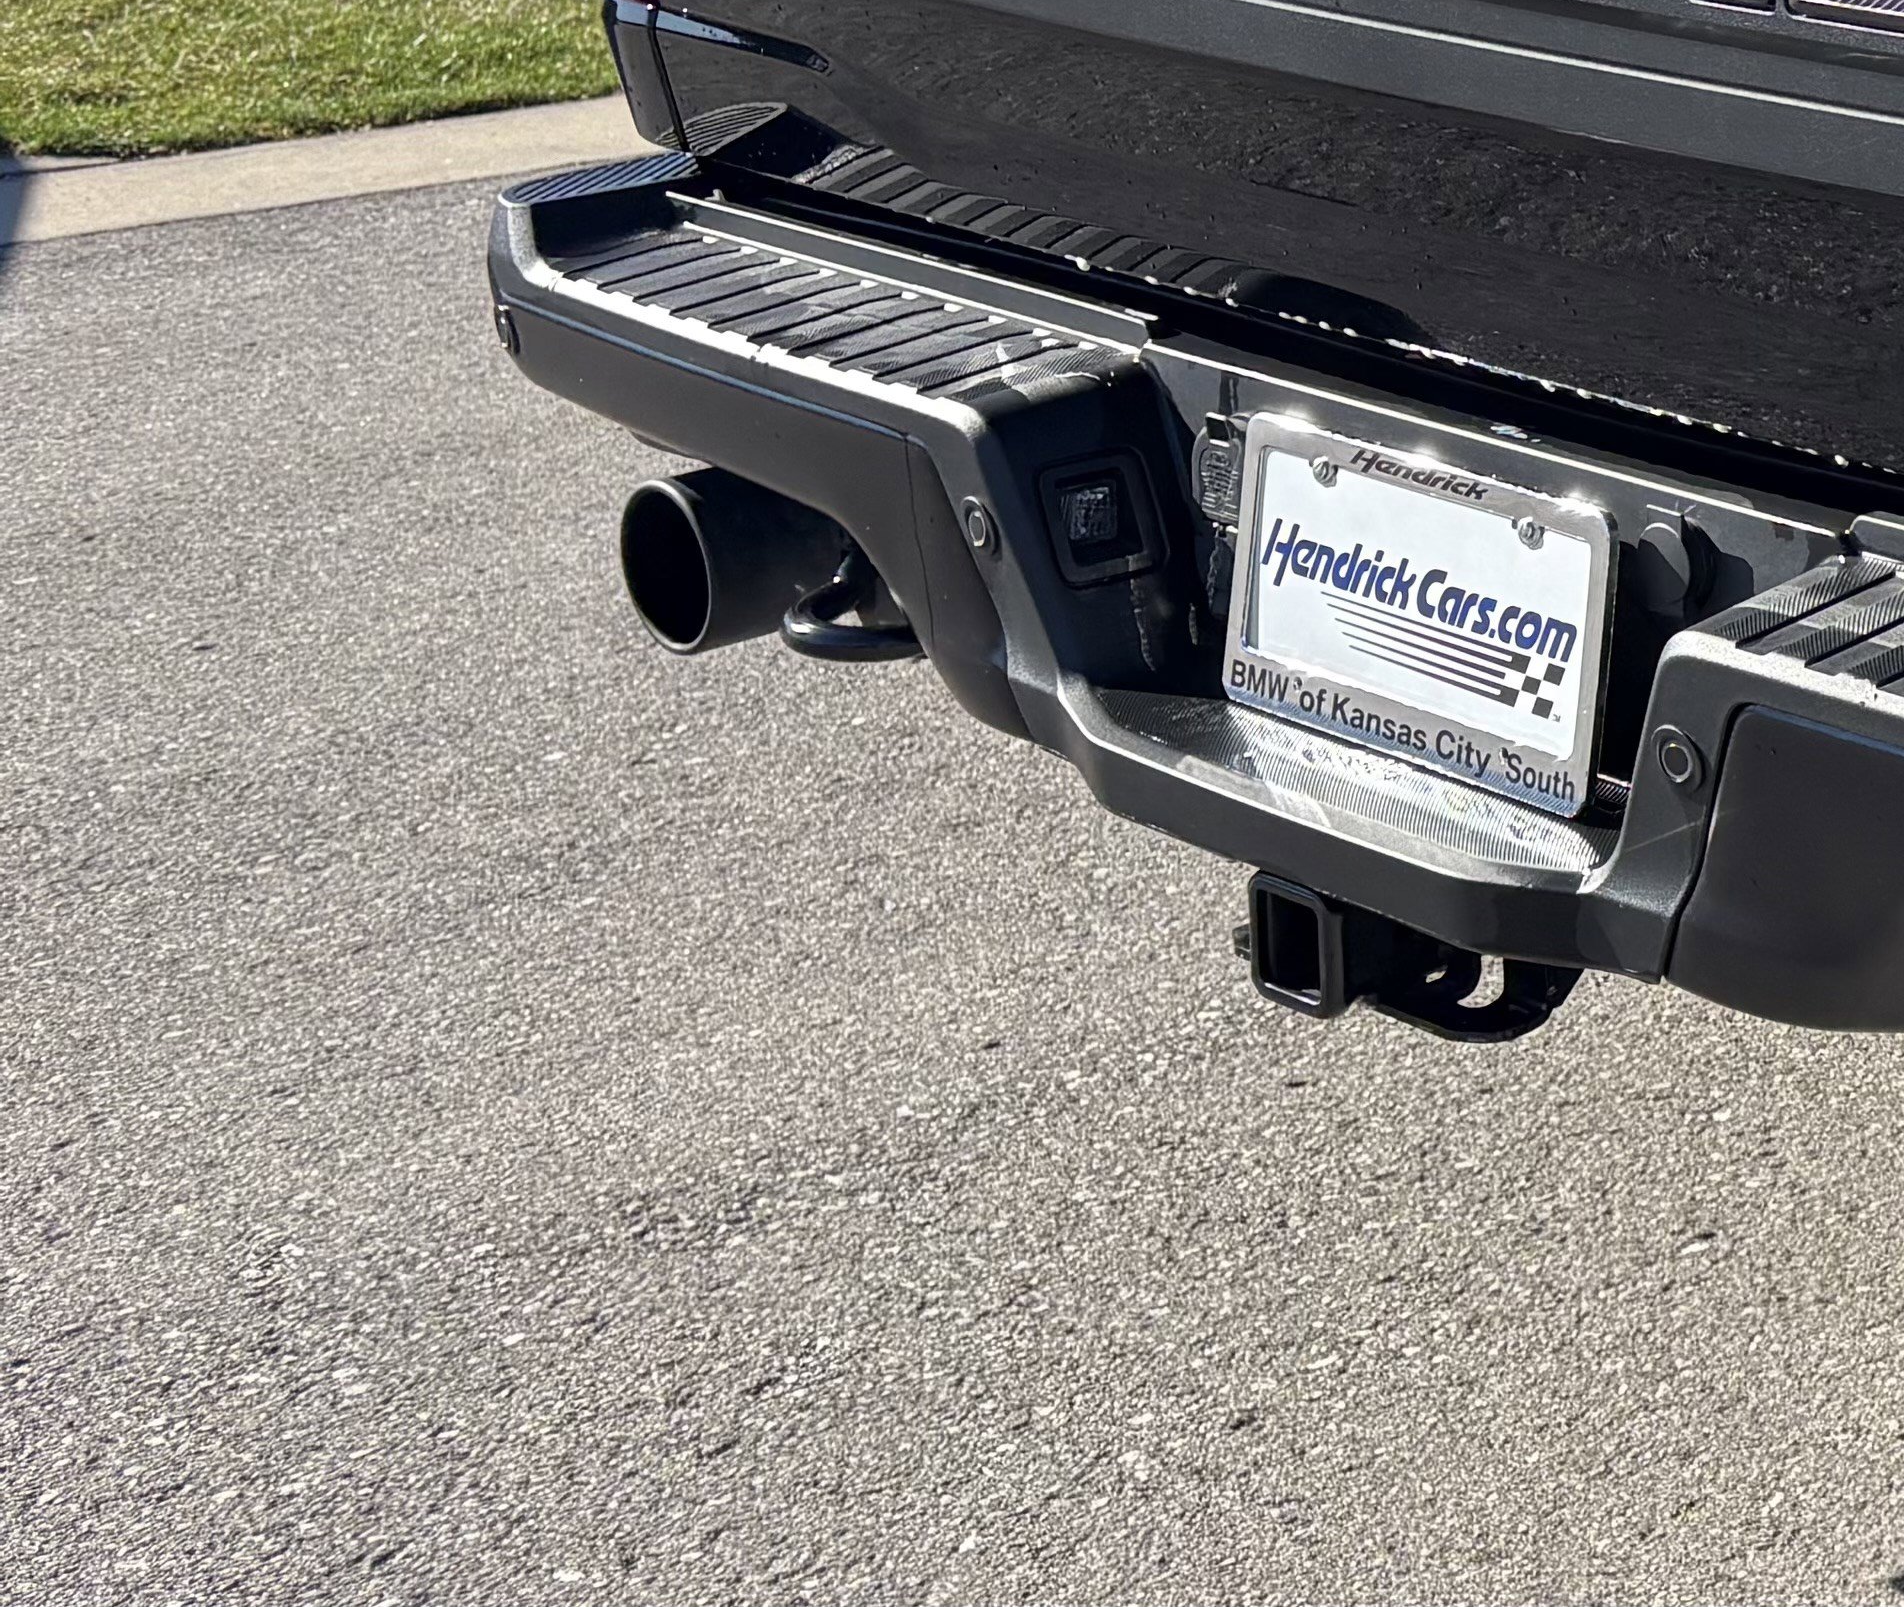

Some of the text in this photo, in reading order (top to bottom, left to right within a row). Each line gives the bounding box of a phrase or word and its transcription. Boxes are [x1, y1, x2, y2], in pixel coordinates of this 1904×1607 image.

[1350, 449, 1490, 501] Hendrick
[1230, 660, 1576, 802] BMW of Kansas City South
